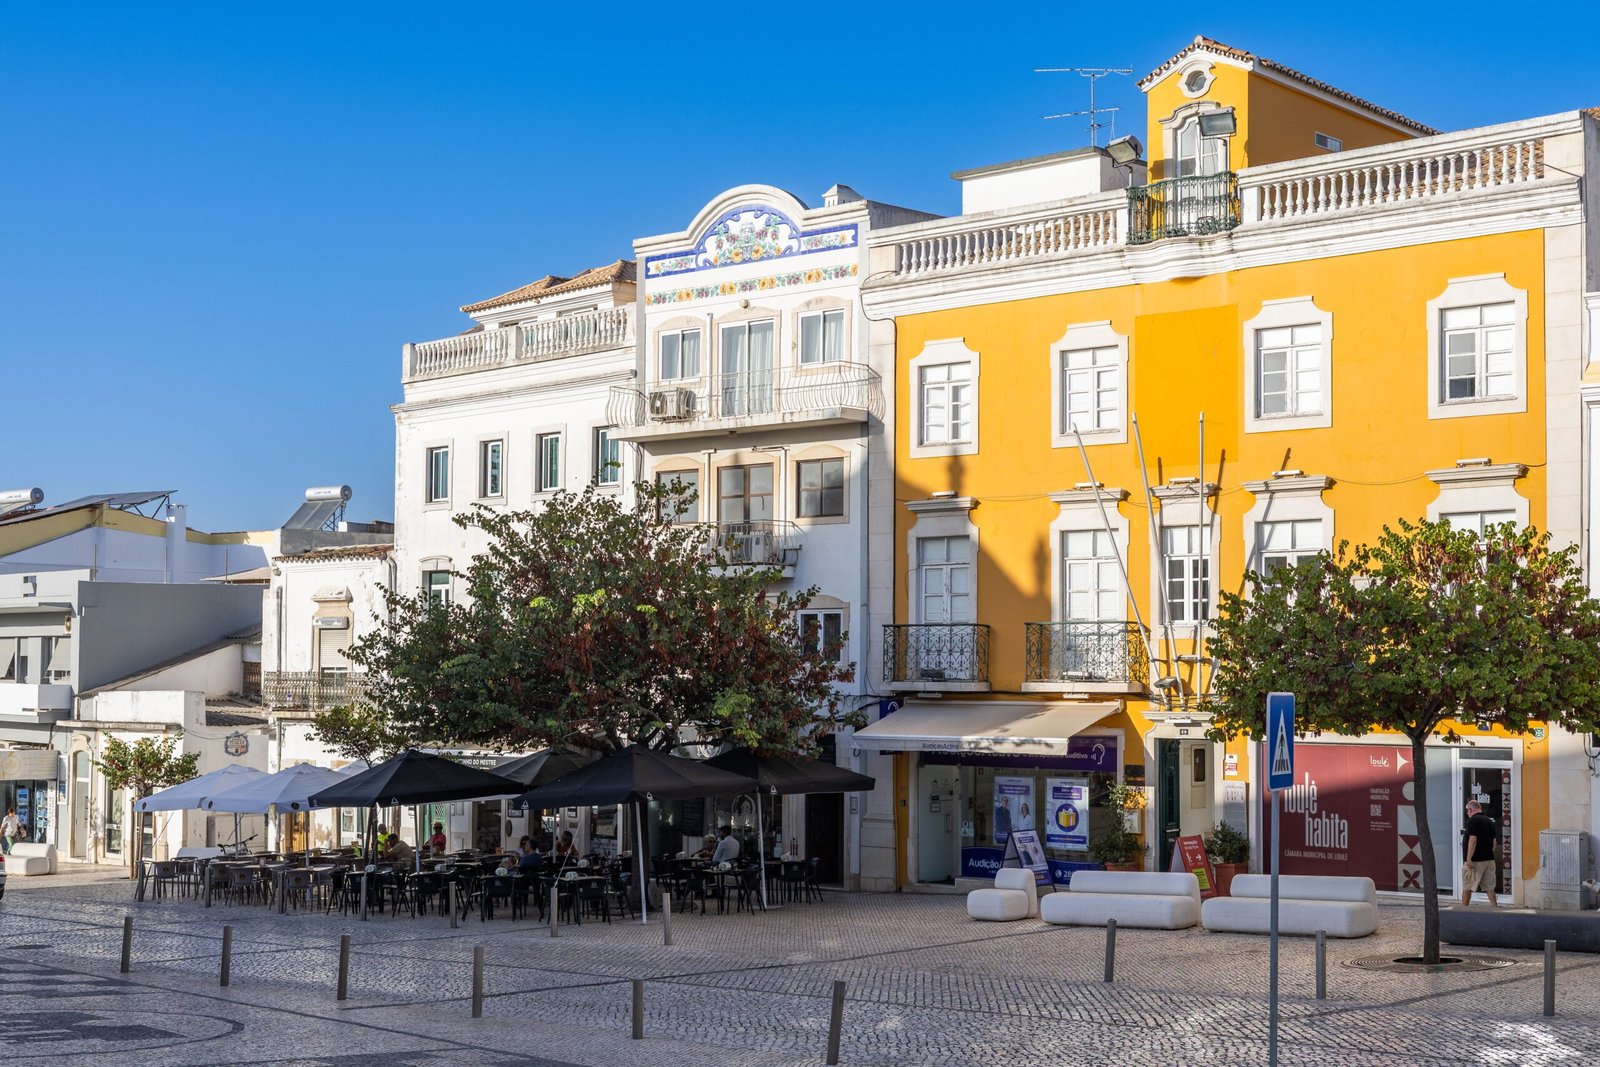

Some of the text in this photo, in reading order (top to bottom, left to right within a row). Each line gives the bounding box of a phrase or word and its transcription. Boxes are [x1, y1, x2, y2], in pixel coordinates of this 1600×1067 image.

[1370, 755, 1390, 768] loulé
[1284, 772, 1317, 813] loulé
[1305, 810, 1348, 849] habita
[1303, 851, 1326, 859] MUNICIPAL
[969, 858, 1002, 869] Audição
